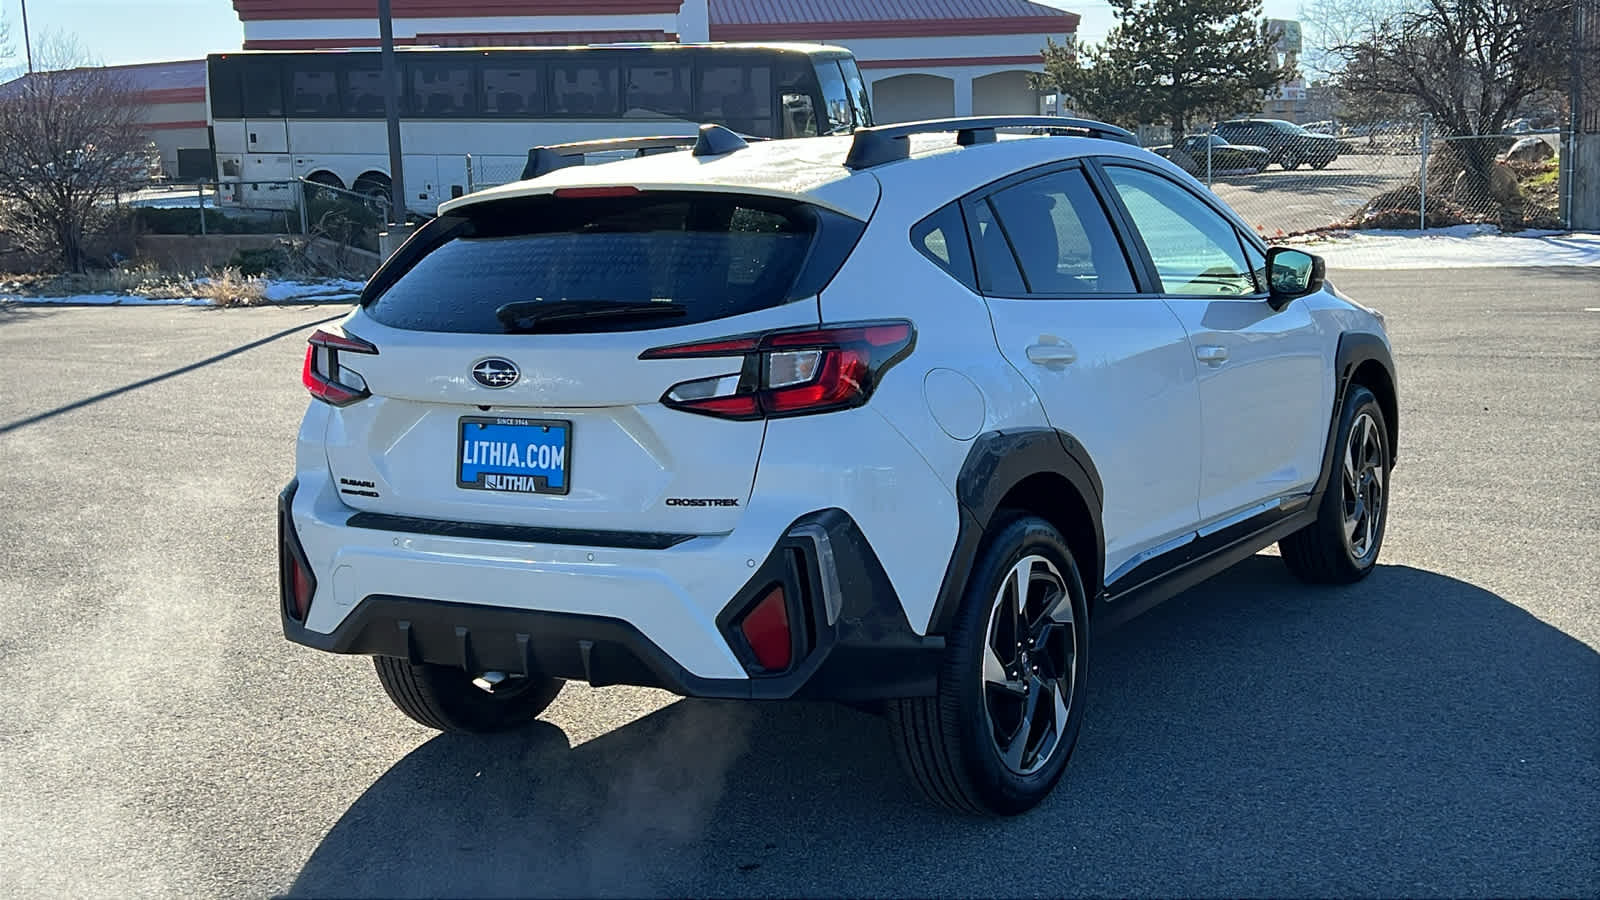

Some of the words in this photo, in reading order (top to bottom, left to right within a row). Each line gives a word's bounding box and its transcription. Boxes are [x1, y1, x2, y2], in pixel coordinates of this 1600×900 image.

[463, 440, 565, 471] LITHIA.COM
[340, 478, 375, 488] SUBARU
[496, 475, 536, 492] LITHIA
[665, 498, 740, 507] CROSSTREK
